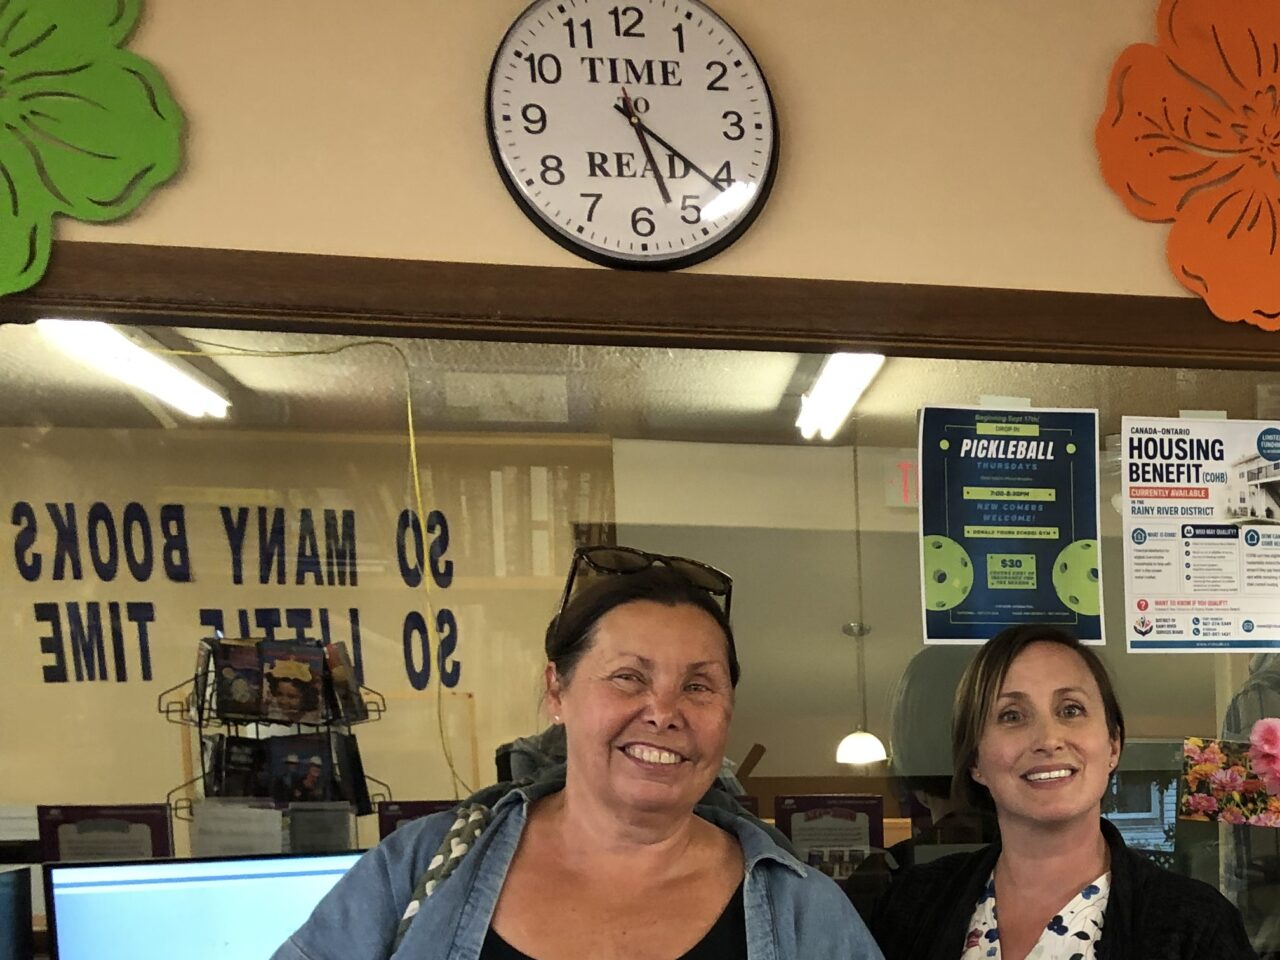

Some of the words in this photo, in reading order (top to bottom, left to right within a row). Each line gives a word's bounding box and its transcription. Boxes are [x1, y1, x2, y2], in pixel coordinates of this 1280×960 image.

[562, 18, 593, 48] 11
[609, 7, 645, 37] 12
[673, 23, 684, 52] 1
[524, 53, 561, 84] 10
[580, 56, 682, 86] TIME
[706, 61, 728, 91] 2
[521, 103, 547, 134] 9
[617, 96, 650, 114] TO
[722, 111, 745, 140] 3
[540, 155, 565, 185] 8
[587, 151, 690, 179] READ
[713, 161, 735, 187] 4
[580, 193, 602, 222] 7
[680, 195, 701, 225] 5
[631, 207, 656, 237] 6
[1130, 427, 1190, 435] CANADA-ONTARIO
[960, 439, 1055, 460] PICKLEBALL
[1128, 437, 1224, 461] HOUSING
[976, 462, 1038, 471] THURSDAYS
[1129, 463, 1203, 483] BENEFIT
[1202, 472, 1228, 484] (COHB)
[1131, 489, 1170, 498] CURRENTLY
[1170, 489, 1206, 498] AVAILABLE
[983, 514, 1036, 522] WELCOME!
[1003, 504, 1044, 512] COMERS
[1131, 506, 1155, 516] RAINY
[1156, 506, 1179, 516] RIVER
[1180, 507, 1214, 517] DISTRICT
[1000, 559, 1023, 569] $30
